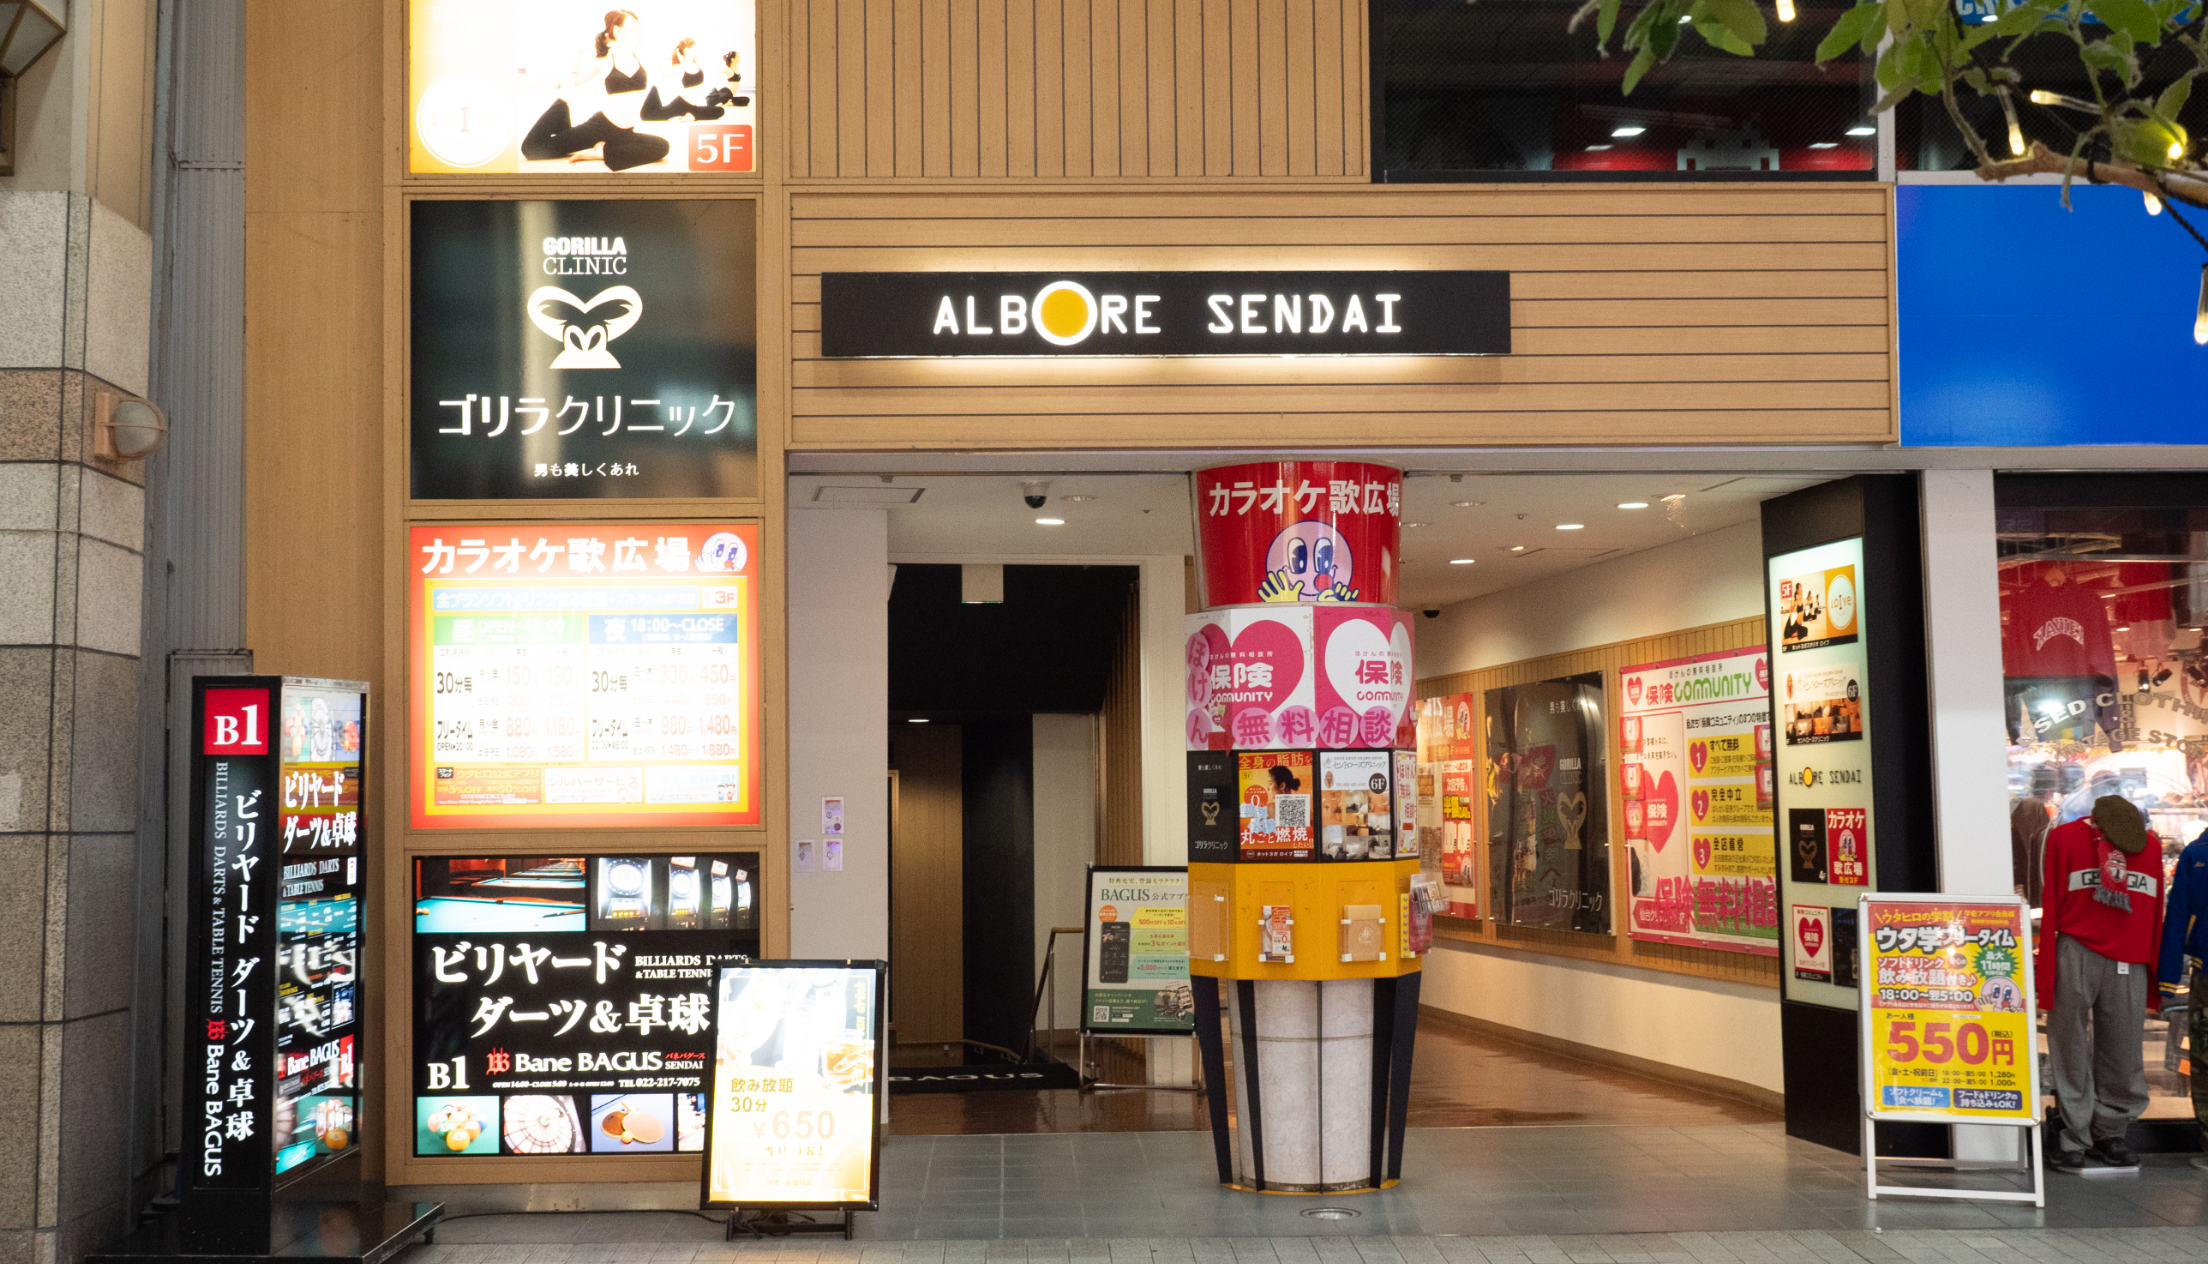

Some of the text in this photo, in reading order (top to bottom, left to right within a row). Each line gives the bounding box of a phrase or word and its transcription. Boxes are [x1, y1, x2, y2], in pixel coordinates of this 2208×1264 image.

[696, 133, 745, 164] 5F
[542, 236, 627, 256] GORILLA
[542, 257, 627, 275] CLINIC
[933, 281, 1403, 346] ALBORE SENDAI
[439, 393, 736, 438] ゴリラクリニック
[534, 462, 640, 478] 男も美しくあれ
[1208, 478, 1400, 518] カラオケ歌広場
[421, 537, 691, 575] カラオケ歌広場
[715, 590, 736, 605] 3F
[1782, 583, 1792, 597] 5F
[452, 619, 474, 643] 昼
[604, 617, 627, 642] 夜
[1211, 662, 1274, 690] 保険
[1355, 659, 1403, 686] 保険
[1646, 682, 1674, 706] 保険
[1847, 685, 1858, 698] 6F
[213, 703, 263, 746] B1
[1236, 708, 1393, 745] 無料相談
[1695, 752, 1702, 768] 1
[2148, 729, 2208, 769] STOR
[1238, 753, 1312, 770] 全身の脂肪を
[456, 769, 539, 779] ウタヒロ公式アプリ
[548, 776, 639, 788] シルバーサービス
[1370, 778, 1385, 790] 6F
[1829, 769, 1862, 785] SENDAI
[213, 761, 229, 841] BILLIARDS
[284, 770, 345, 811] ビリヤード
[1697, 801, 1703, 816] 2
[1828, 811, 1865, 829] カラオケ
[283, 811, 357, 854] ダーツ&卓球
[1240, 826, 1308, 846] 丸ごと燃焼
[283, 857, 340, 881] BILLIARDS DARTS
[1699, 850, 1705, 864] 3
[1833, 861, 1863, 876] 歌広場
[212, 846, 227, 895] DARTS
[2081, 870, 2148, 891] GEGIA
[1100, 888, 1150, 901] BAGUS
[211, 907, 226, 955] TABLE
[225, 789, 263, 1142] ビリヤード ダーツ&卓球
[431, 941, 628, 987] ビリヤード
[634, 955, 702, 967] BILLIARDS
[1877, 956, 1945, 969] ソフトドリンク
[210, 956, 225, 1014] TENNIS
[677, 968, 713, 979] TENNI
[470, 992, 711, 1039] ダーツ&卓球
[1886, 1012, 1915, 1020] お一人様
[1887, 1020, 2015, 1066] 550円
[287, 1055, 310, 1077] Bane
[309, 1038, 340, 1068] BAGUS
[514, 1051, 664, 1073] Bane BAGUS
[664, 1060, 704, 1070] SENDAI
[427, 1055, 471, 1090] B1
[730, 1077, 794, 1093] 飲み放題
[204, 1044, 225, 1177] Bane BAGUS
[730, 1096, 768, 1113] 30分
[751, 1110, 836, 1140] ¥650
